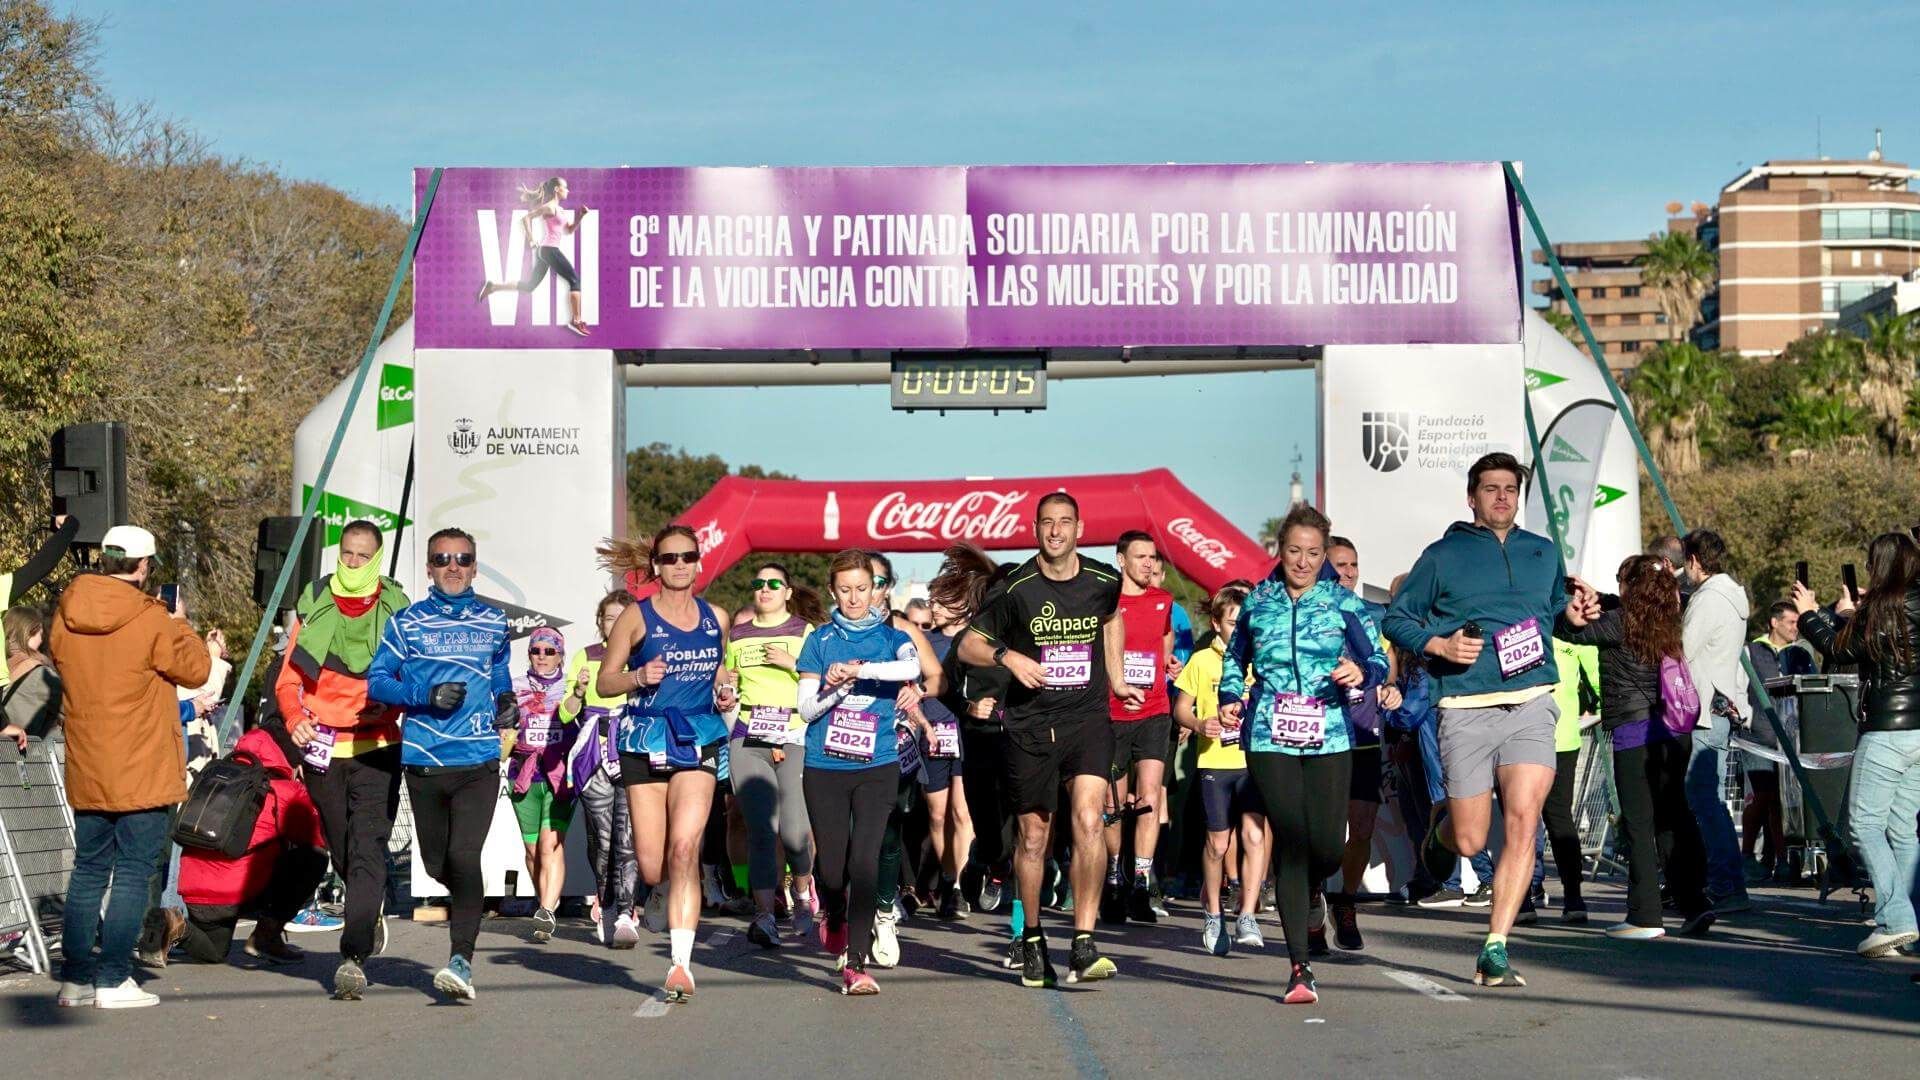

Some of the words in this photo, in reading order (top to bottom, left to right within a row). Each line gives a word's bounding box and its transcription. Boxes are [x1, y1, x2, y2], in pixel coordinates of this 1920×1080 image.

[629, 214, 660, 257] 8ª
[667, 214, 793, 257] MARCHA
[803, 214, 825, 256] Y
[833, 213, 976, 256] PATINADA
[986, 212, 1140, 255] SOLIDARIA
[1151, 212, 1210, 254] POR
[1221, 211, 1255, 254] LA
[1265, 204, 1457, 253] ELIMINACIÓN
[629, 266, 664, 308] DE
[672, 266, 703, 308] LA
[713, 265, 857, 308] VIOLENCIA
[865, 265, 979, 308] CONTRA
[987, 264, 1038, 307] LAS
[1046, 263, 1179, 306] MUJERES
[1188, 263, 1208, 305] Y
[1215, 263, 1272, 305] POR
[1282, 263, 1315, 305] LA
[1322, 262, 1458, 304] IGUALDAD
[902, 366, 1035, 395] 0:00:05
[1417, 414, 1485, 426] Fundació
[486, 427, 581, 439] AJUNTAMENT
[1417, 429, 1488, 443] Esportiva
[486, 443, 505, 455] DE
[510, 440, 581, 455] VALÈNCIA
[1417, 443, 1489, 457] Municipal
[866, 490, 1029, 541] Coca-Cola
[1166, 517, 1236, 570] Coca-Cola
[506, 614, 547, 634] nglés
[665, 647, 719, 662] POBLATS
[1503, 641, 1540, 665] 2024
[665, 660, 719, 674] MARÍTIMS
[1044, 665, 1087, 679] 2024
[751, 722, 785, 733] 2024
[1276, 718, 1321, 734] 2024
[529, 731, 560, 742] 2024
[830, 730, 871, 748] 2024
